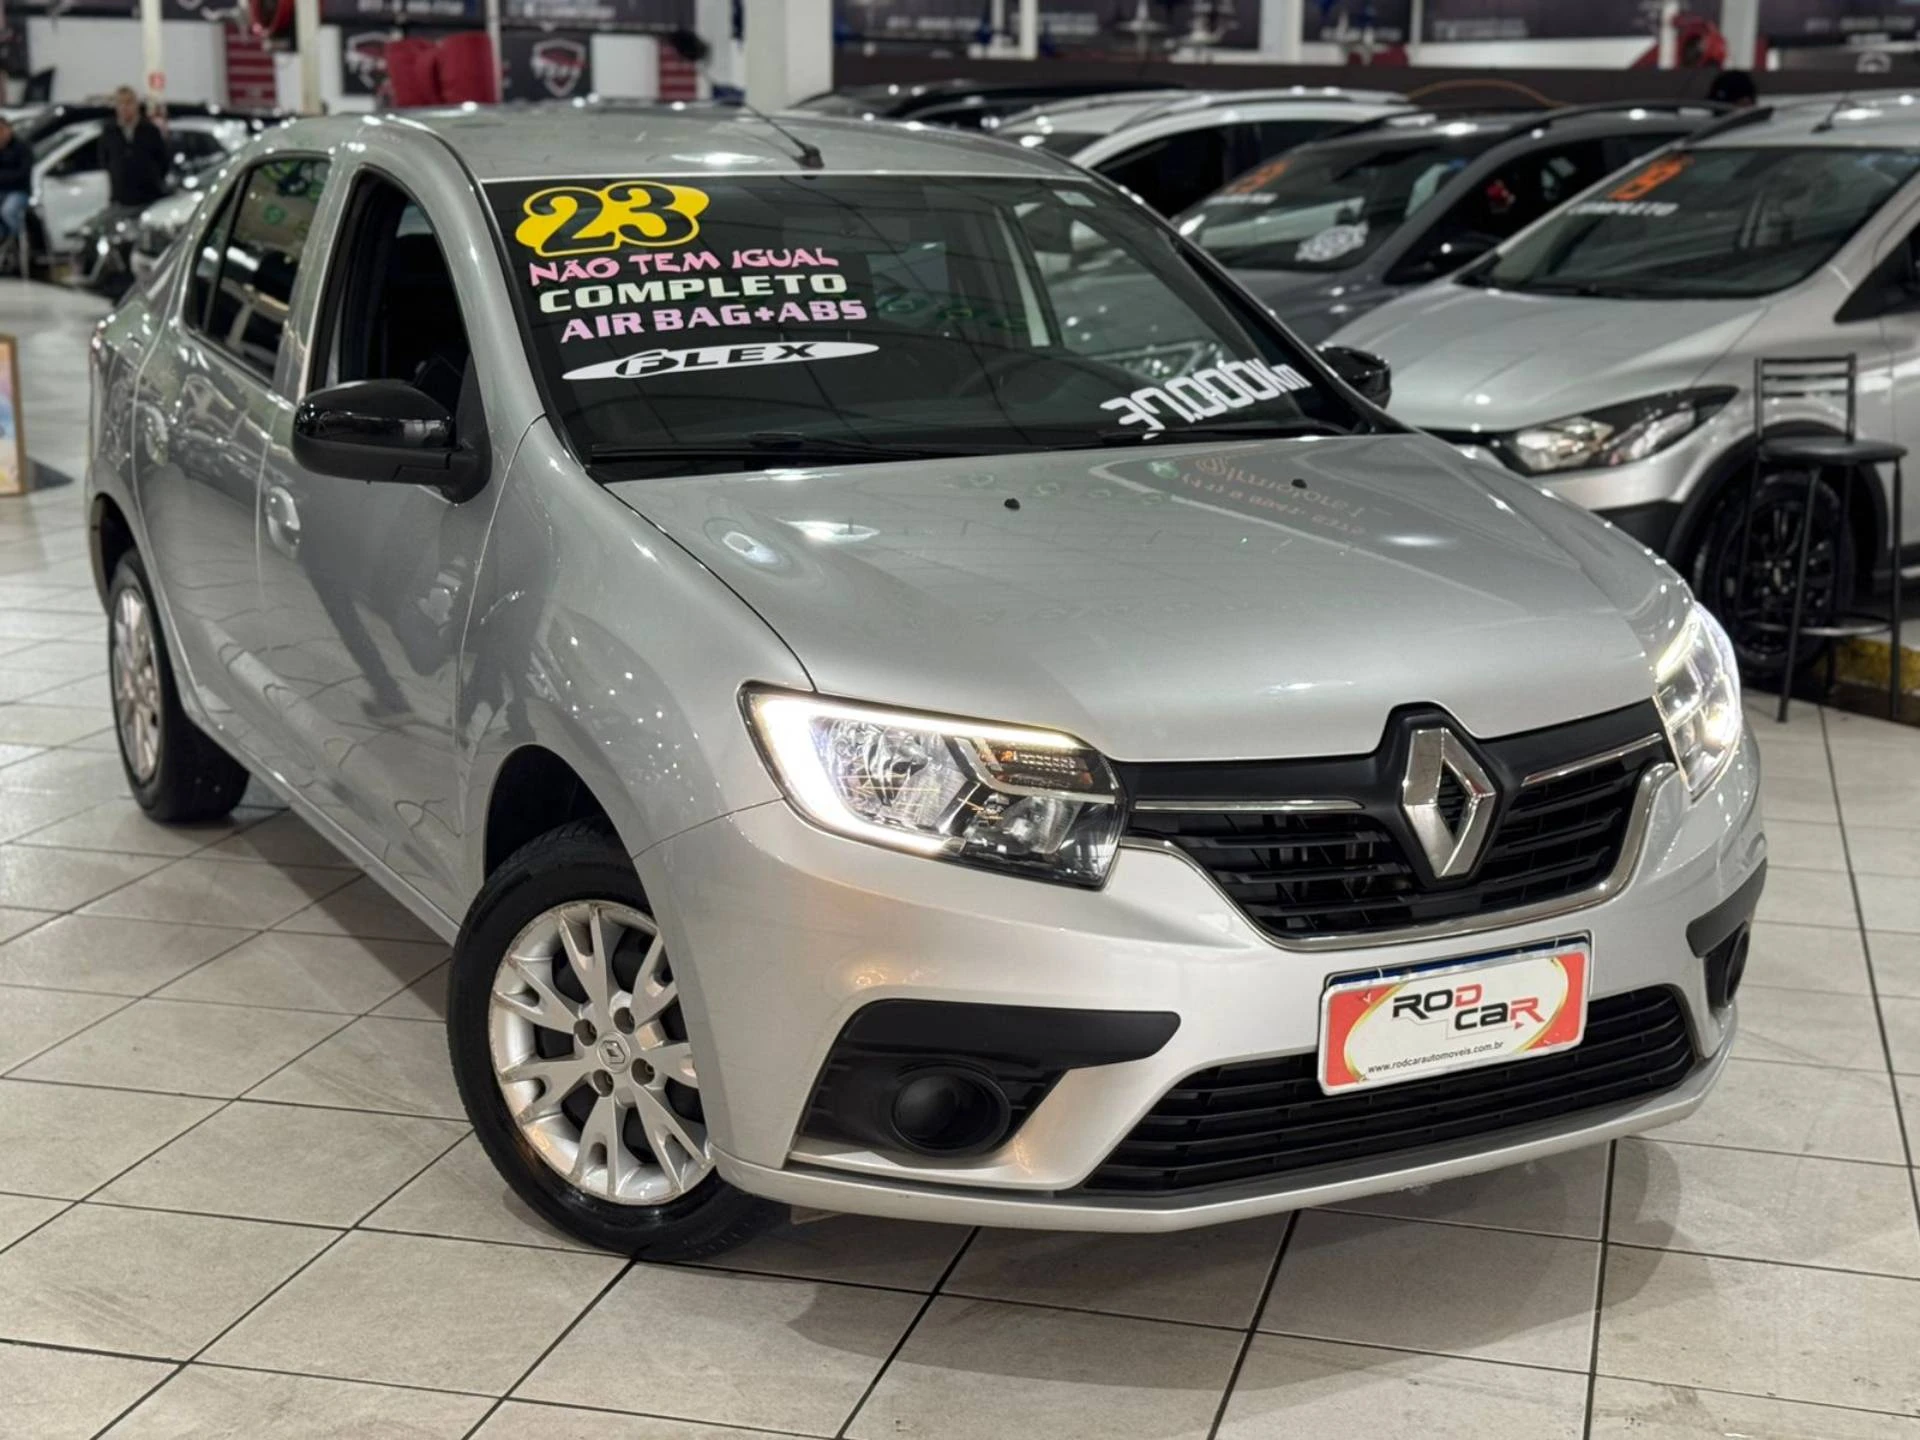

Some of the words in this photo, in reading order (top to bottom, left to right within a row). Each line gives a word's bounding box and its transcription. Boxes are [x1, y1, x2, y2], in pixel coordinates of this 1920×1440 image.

[526, 182, 697, 255] 23
[529, 257, 620, 286] NÃO
[628, 251, 721, 275] TEM
[731, 248, 839, 269] IGUAL
[539, 274, 848, 313] COMPLETO
[560, 312, 645, 343] AIR
[653, 299, 868, 331] BAG+ABS
[618, 342, 819, 376] FLEX
[1391, 983, 1483, 1020] ROD
[1367, 1040, 1504, 1073] www.rodcarautomoveis.com.br
